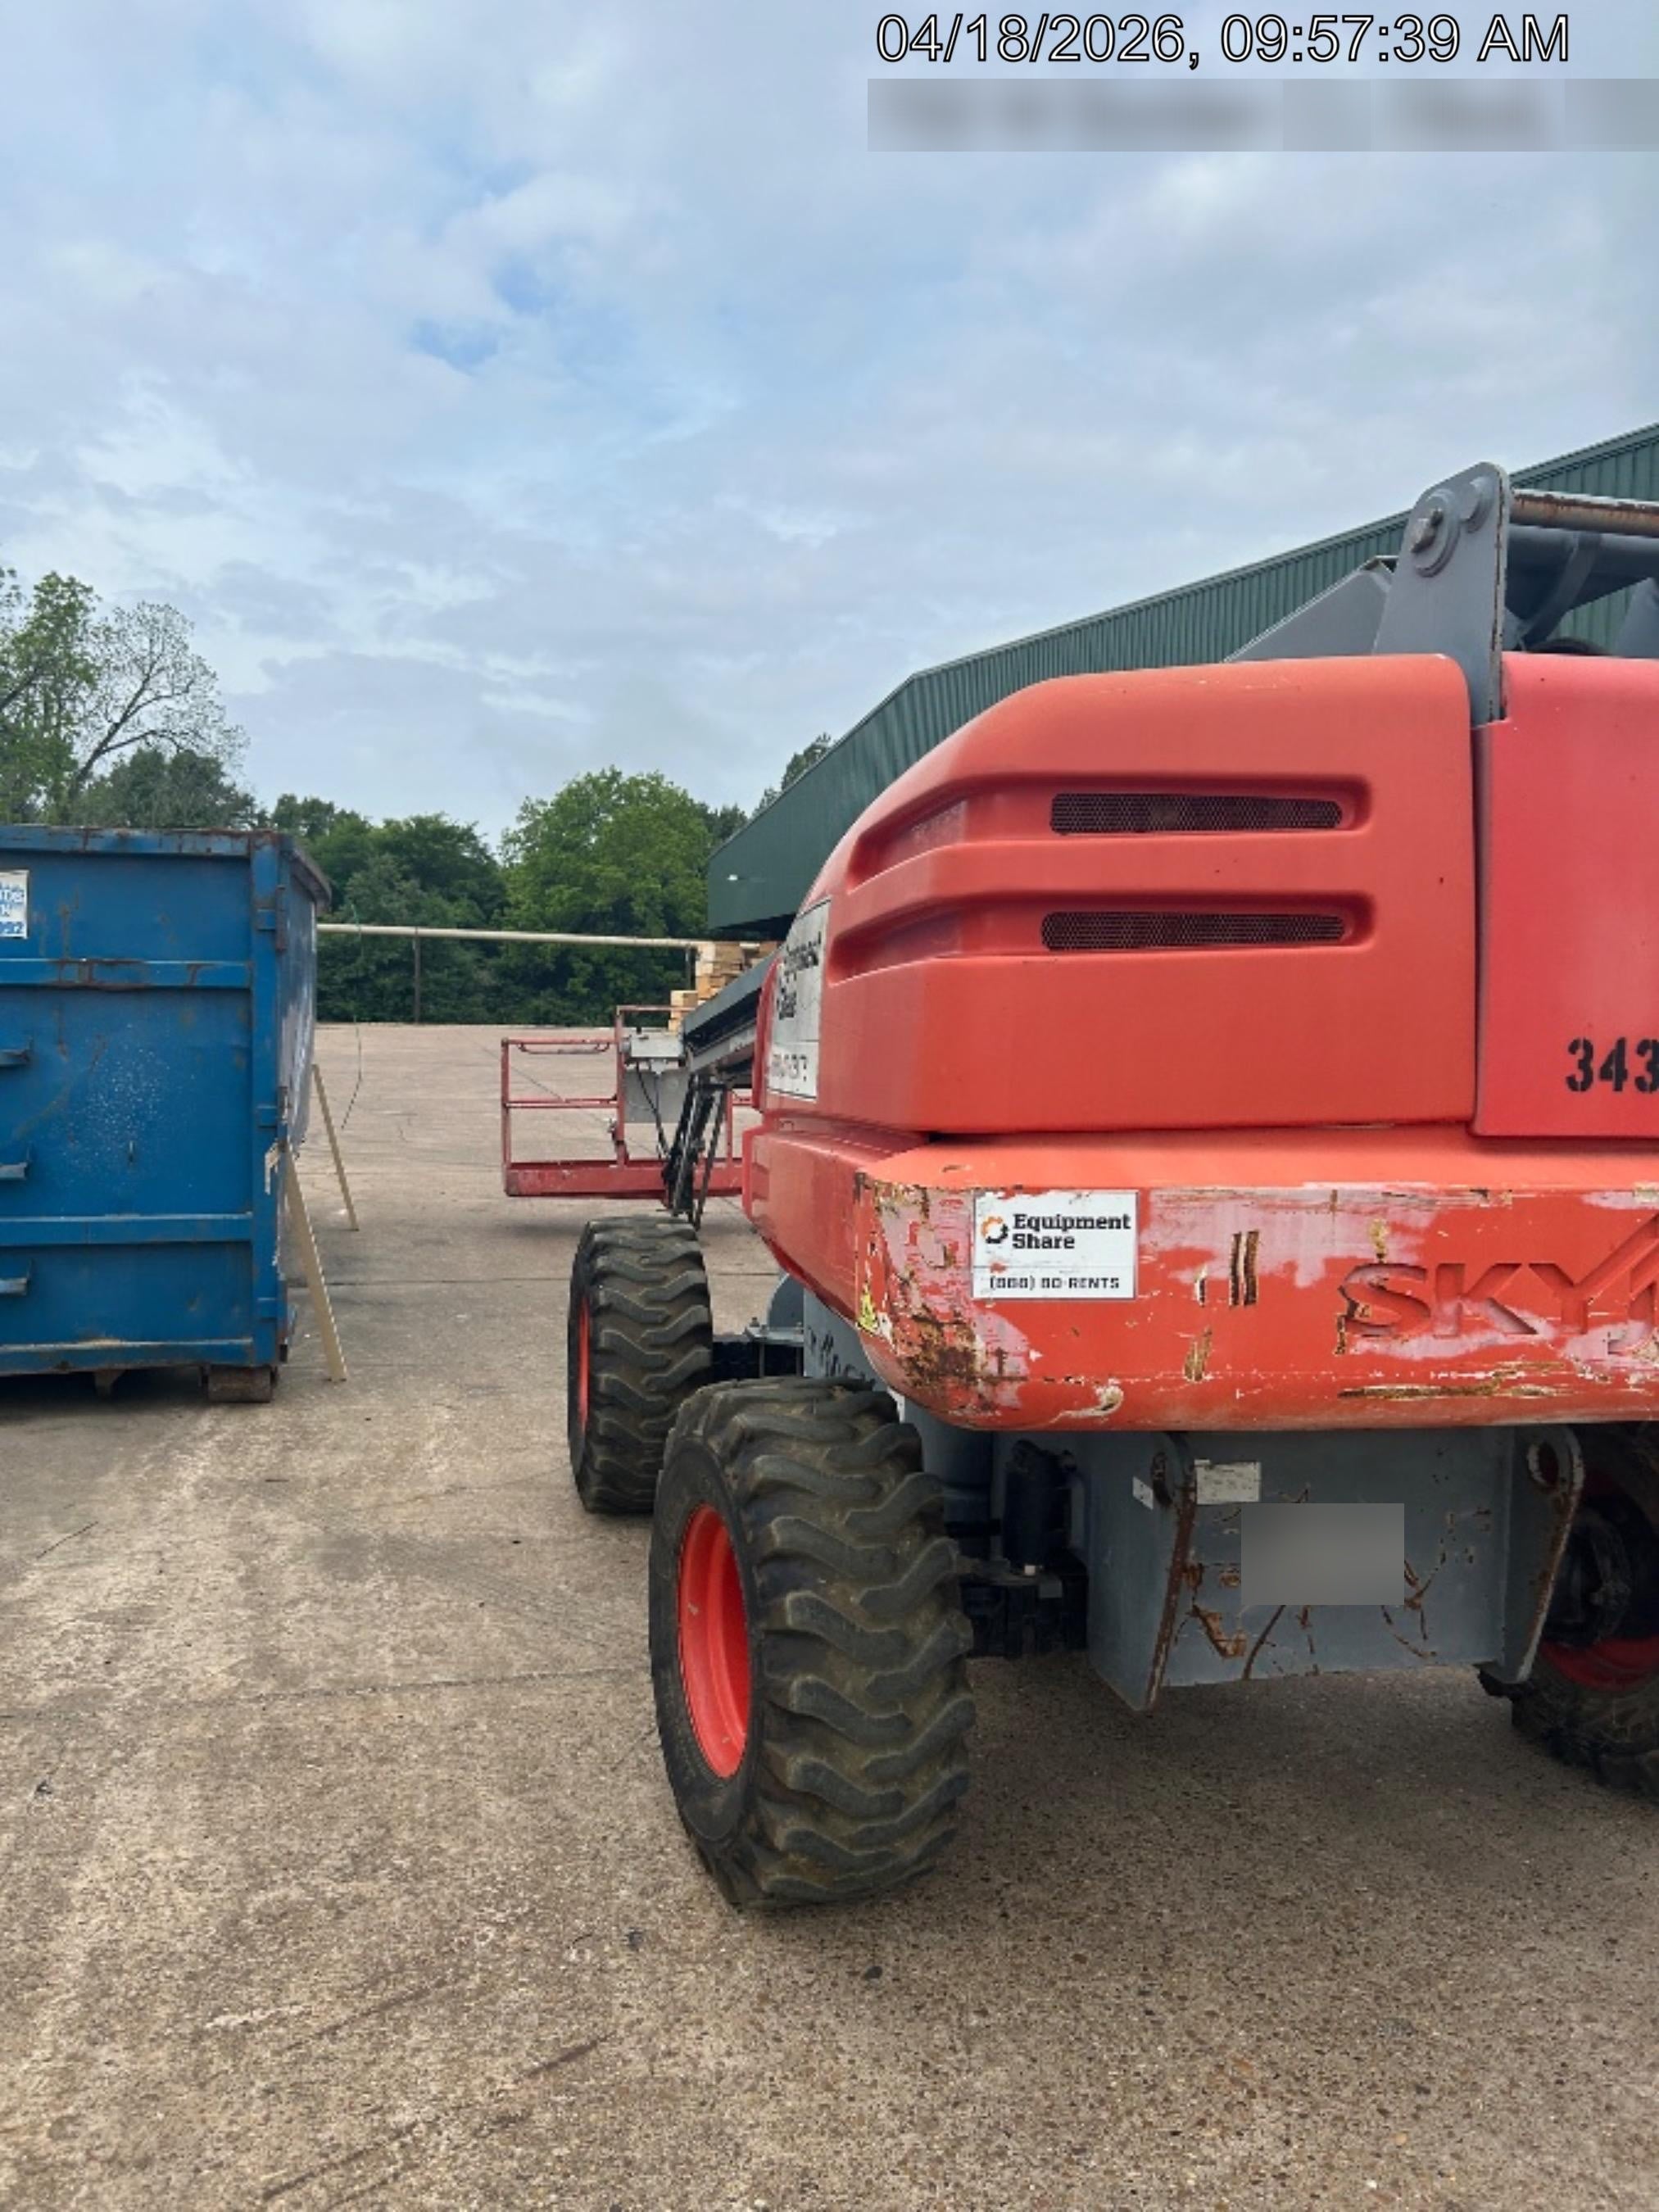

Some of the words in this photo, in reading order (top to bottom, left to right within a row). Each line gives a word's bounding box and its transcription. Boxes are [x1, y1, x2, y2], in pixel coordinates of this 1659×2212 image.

[1566, 1036, 1659, 1094] 343
[1012, 1213, 1131, 1233] Equipment
[1012, 1233, 1076, 1250] Share
